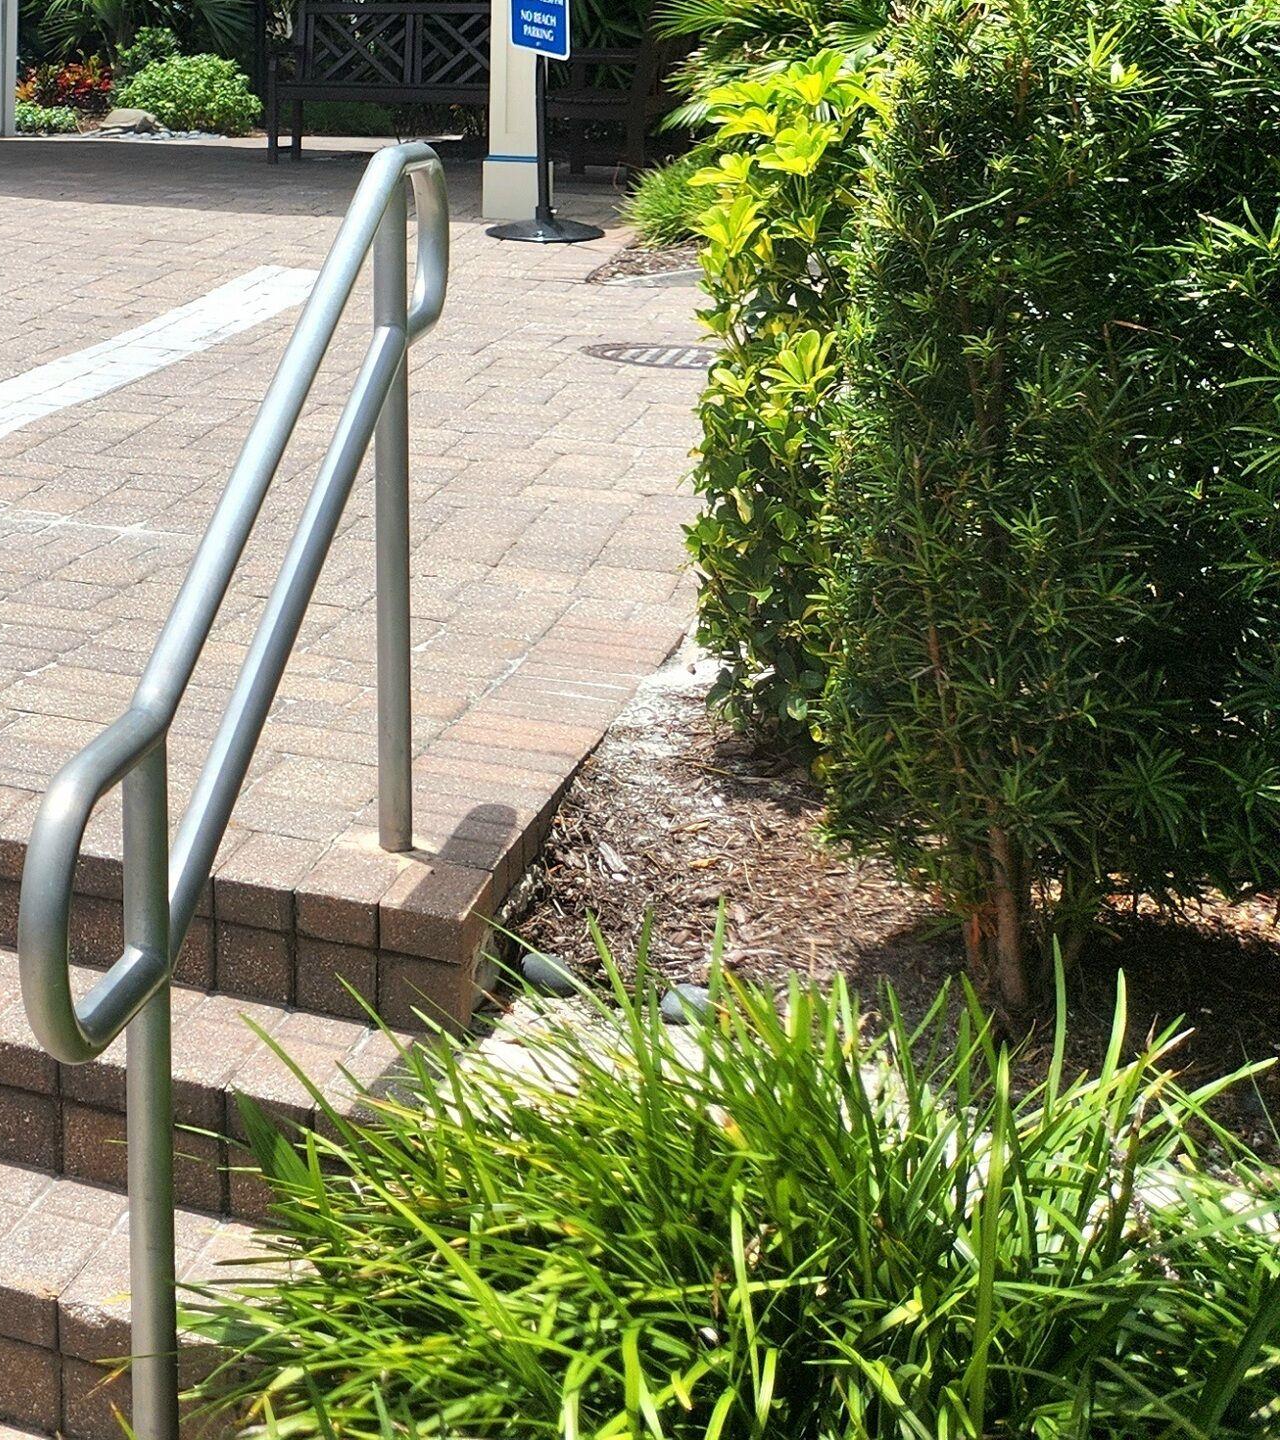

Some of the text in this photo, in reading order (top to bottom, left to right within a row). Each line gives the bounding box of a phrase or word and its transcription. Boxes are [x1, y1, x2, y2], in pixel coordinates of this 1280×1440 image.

[520, 9, 556, 27] NO BEACH
[523, 24, 554, 41] PARKING
